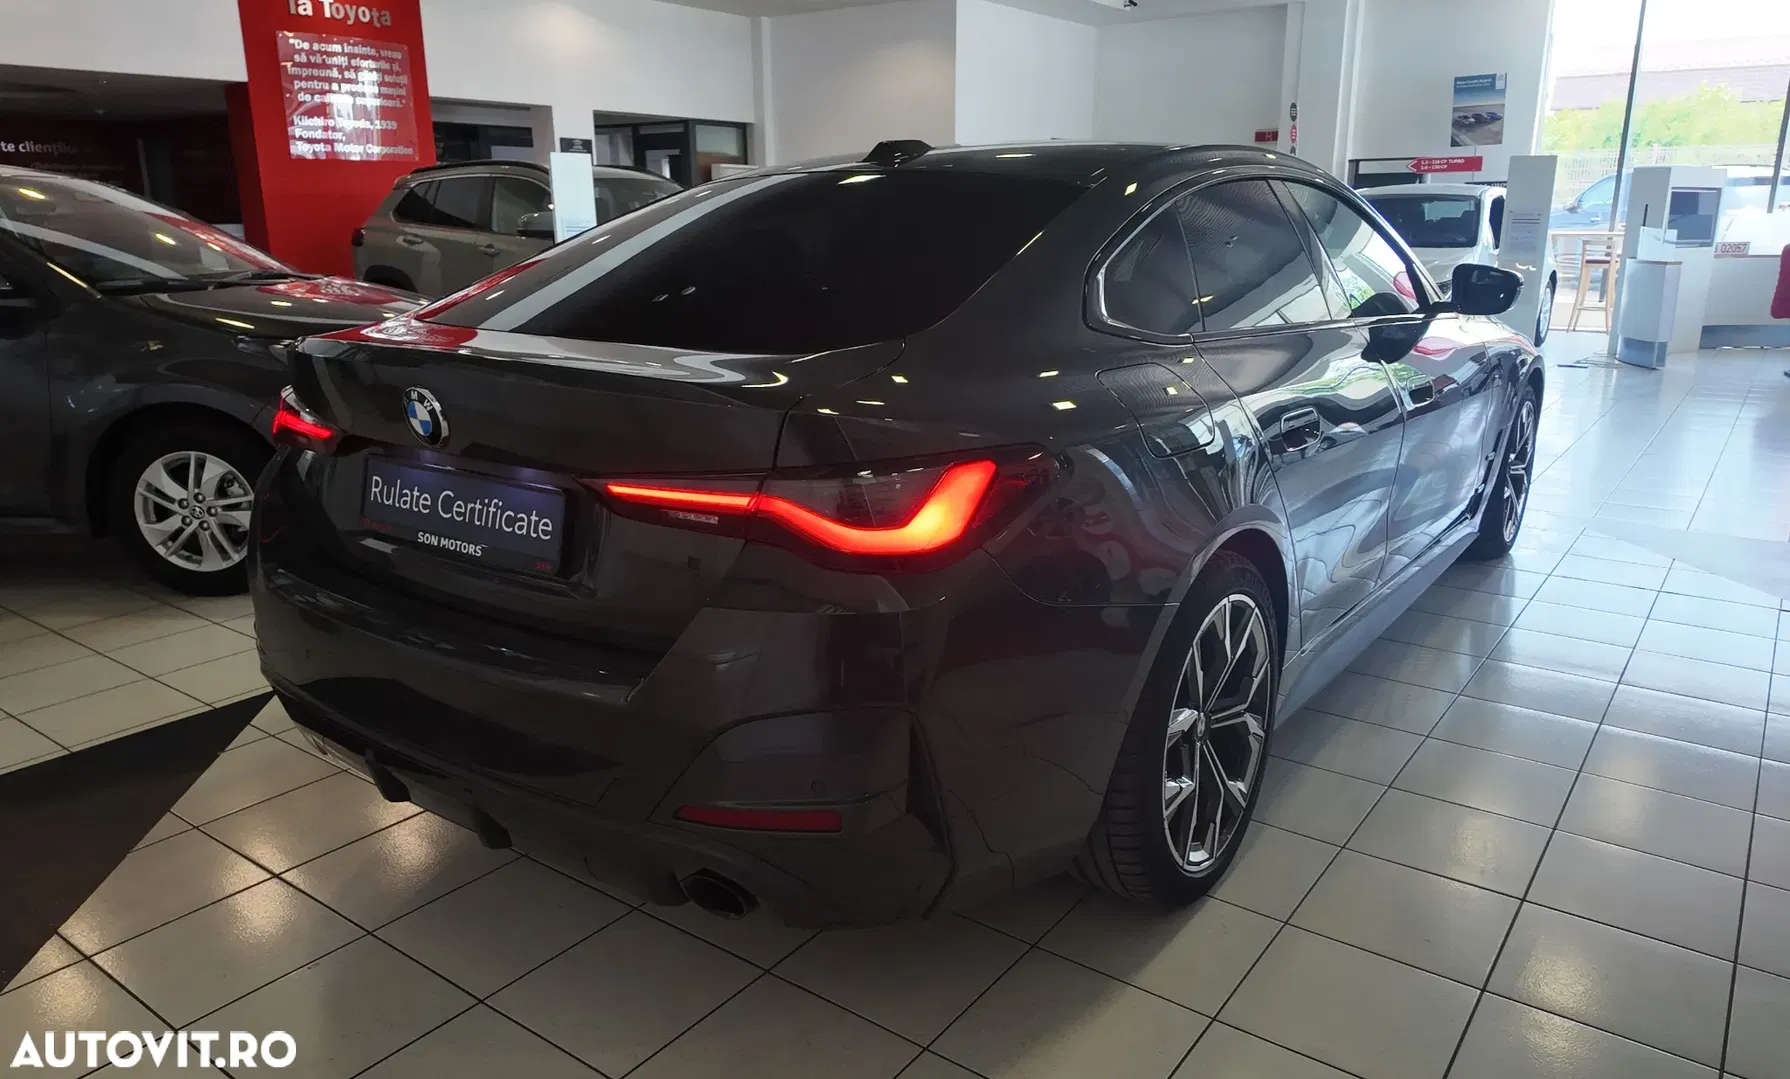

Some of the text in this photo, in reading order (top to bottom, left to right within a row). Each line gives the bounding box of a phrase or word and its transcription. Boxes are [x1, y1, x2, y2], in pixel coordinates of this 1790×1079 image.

[319, 0, 391, 27] Toyota
[312, 43, 342, 53] acum
[293, 53, 307, 63] să
[294, 80, 329, 90] pentru
[297, 91, 312, 102] de
[294, 128, 346, 141] Fondator,
[295, 141, 332, 153] Toyota
[370, 475, 553, 540] Rulate Certificate
[417, 531, 483, 557] SON MOTORS
